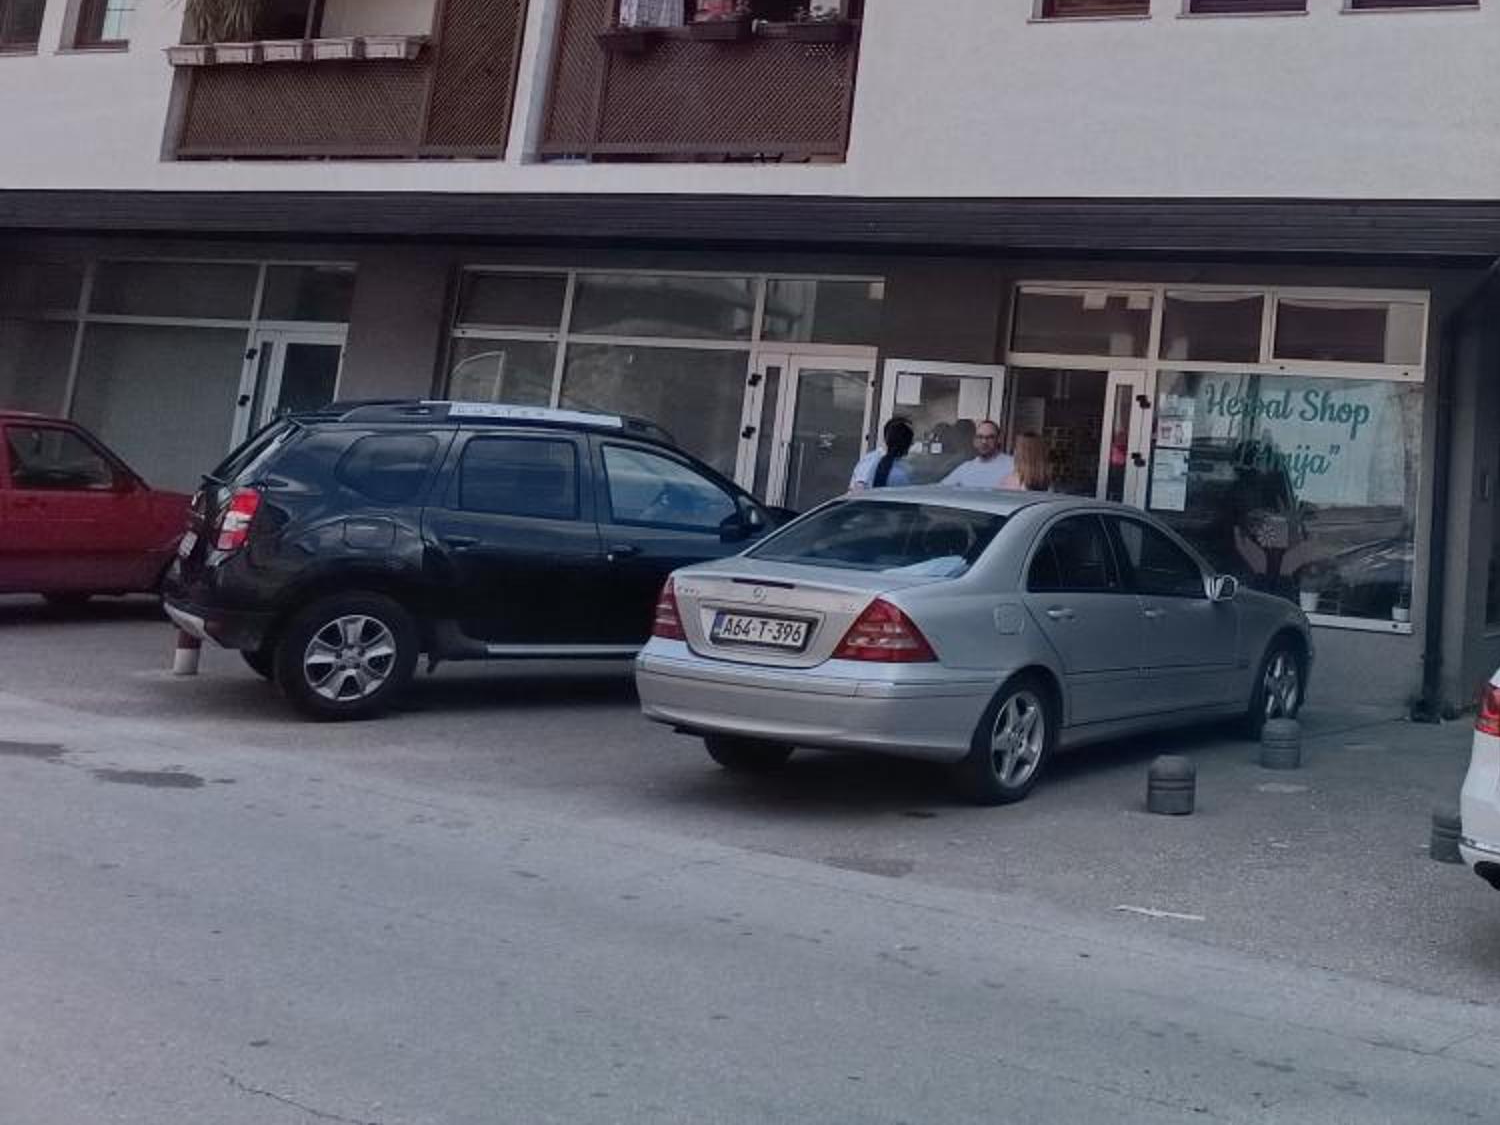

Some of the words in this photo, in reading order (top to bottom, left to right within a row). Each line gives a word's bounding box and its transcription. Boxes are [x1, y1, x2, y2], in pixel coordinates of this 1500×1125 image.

[1205, 381, 1293, 419] Herbal
[1299, 389, 1370, 440] Shop
[722, 616, 802, 644] A64-T-396
